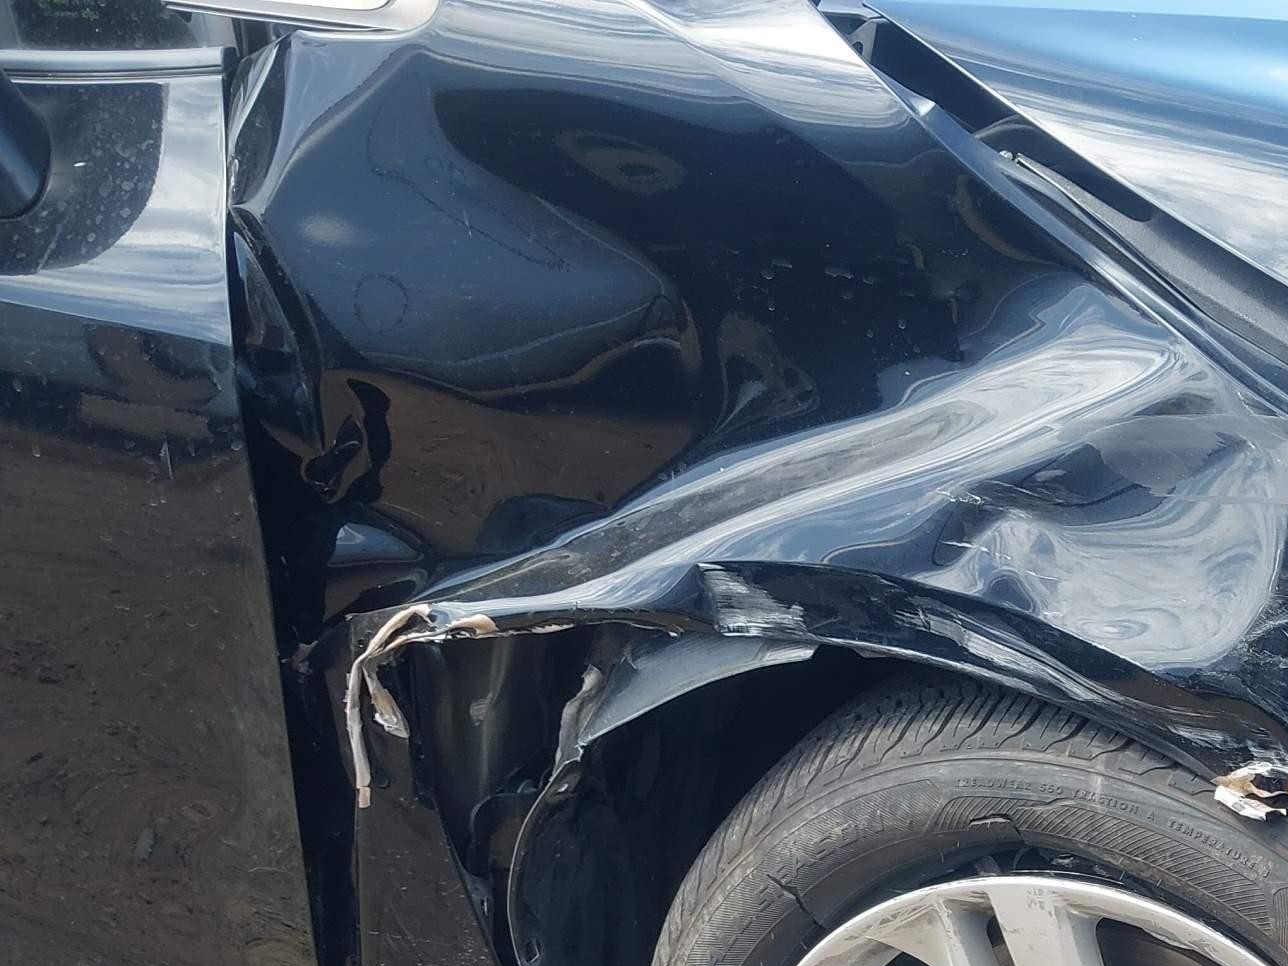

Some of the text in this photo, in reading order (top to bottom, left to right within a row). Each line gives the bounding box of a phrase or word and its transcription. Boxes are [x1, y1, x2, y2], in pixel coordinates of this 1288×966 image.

[752, 808, 886, 913] SEASON
[1072, 788, 1141, 815] TRACTION
[1167, 817, 1257, 870] TEMPERATURE
